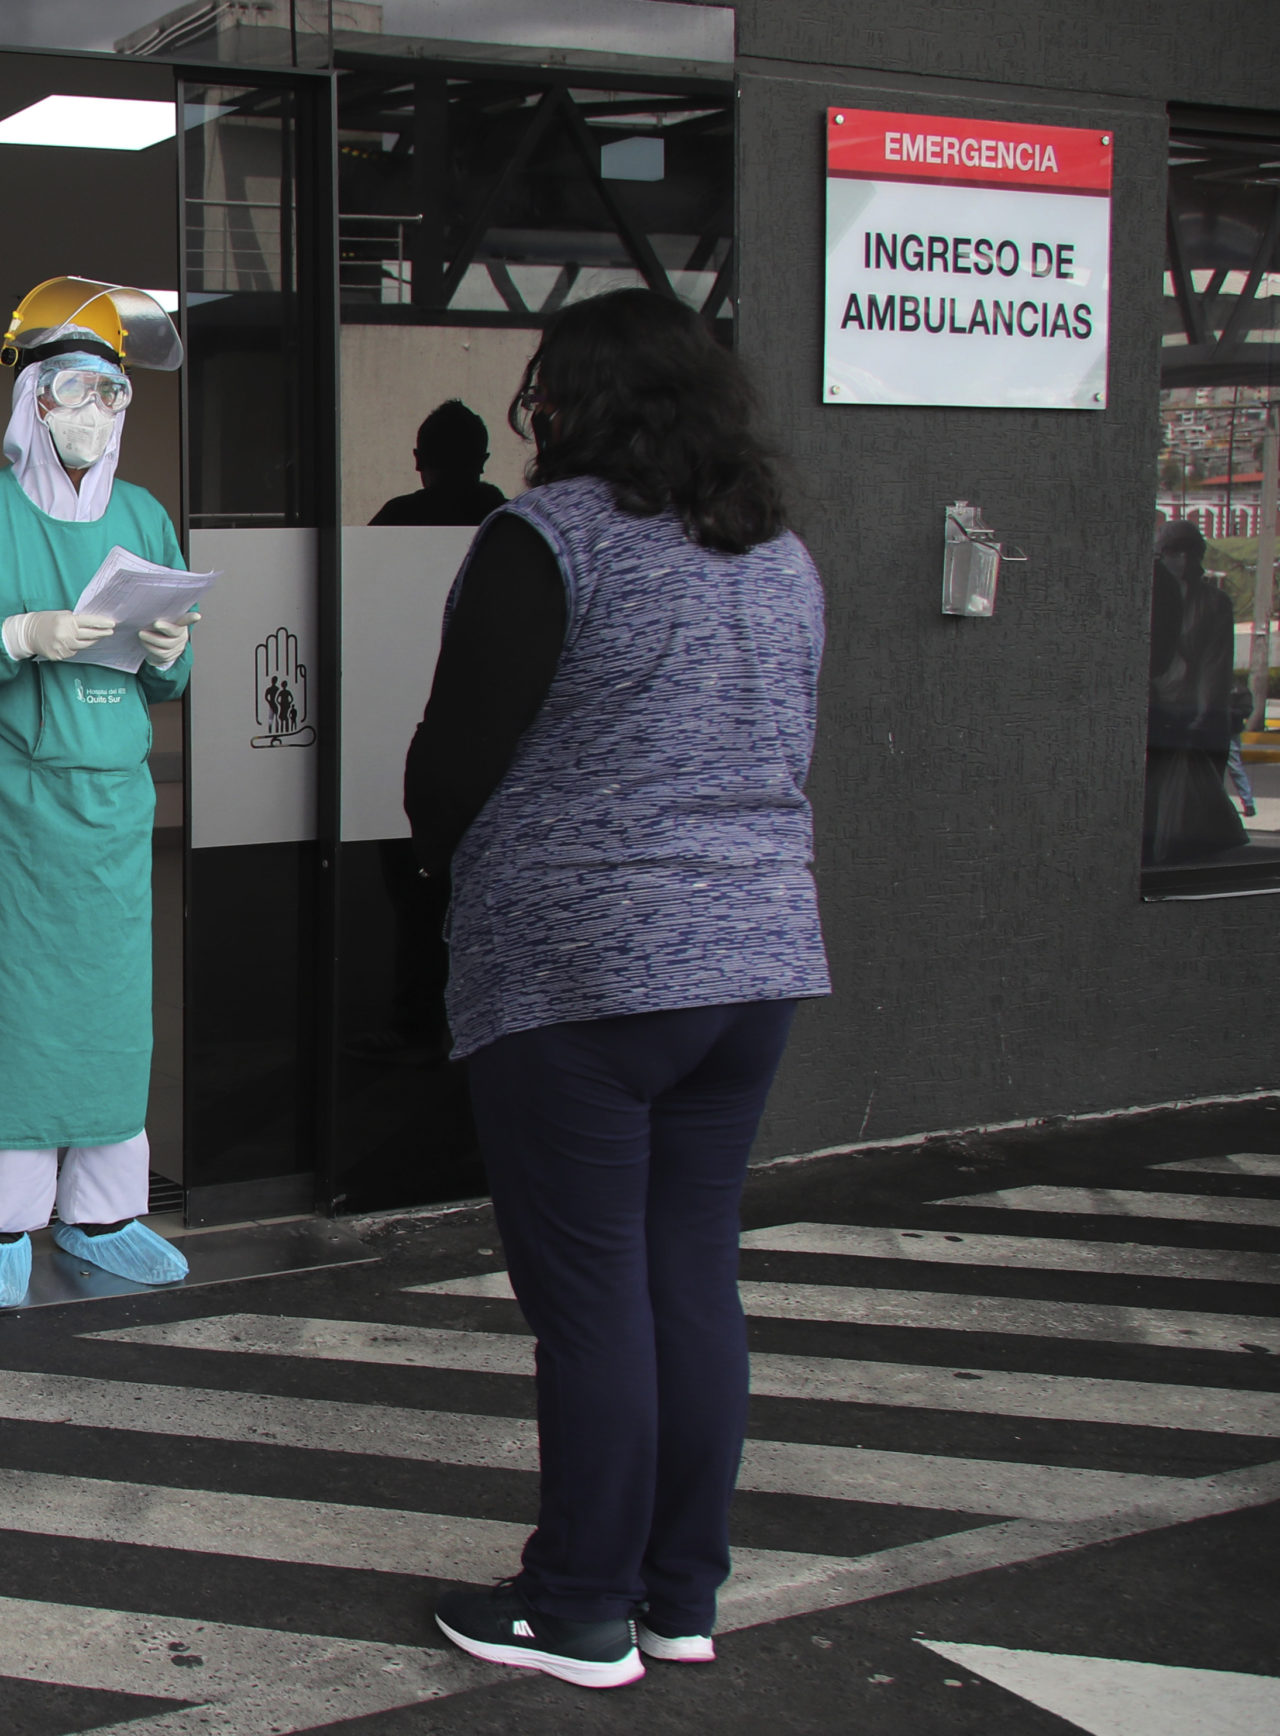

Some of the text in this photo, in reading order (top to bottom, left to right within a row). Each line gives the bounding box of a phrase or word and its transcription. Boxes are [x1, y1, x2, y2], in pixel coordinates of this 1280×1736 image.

[884, 131, 1059, 173] EMERGENCIA
[864, 231, 1075, 280] INGRESO DE
[840, 292, 1093, 340] AMBULANCIAS
[86, 695, 121, 703] Quito Sur
